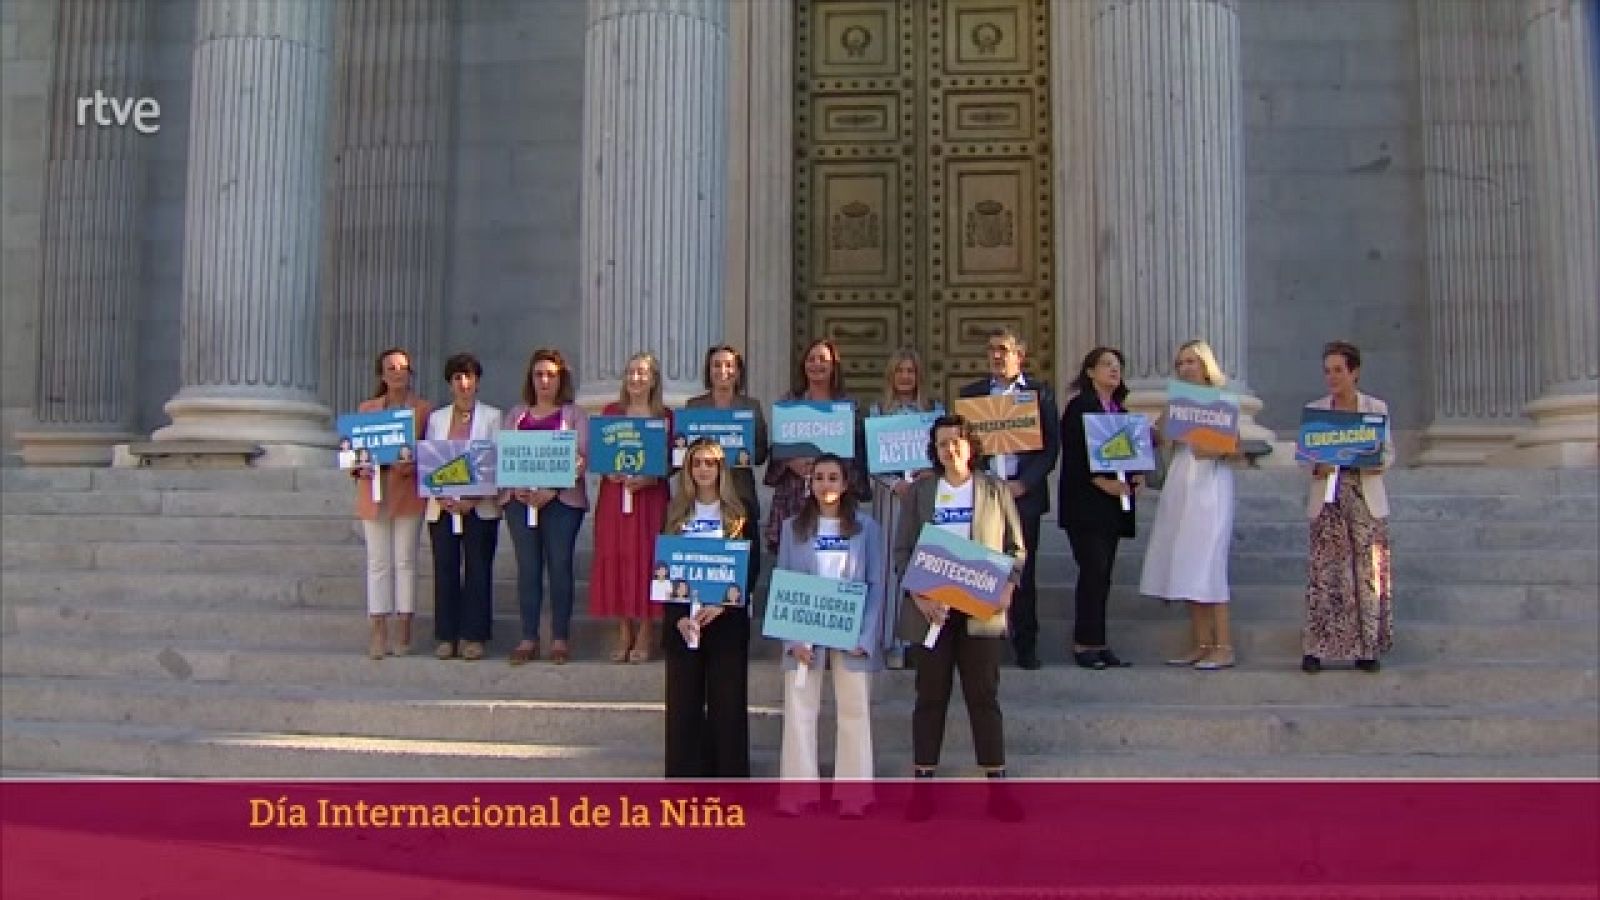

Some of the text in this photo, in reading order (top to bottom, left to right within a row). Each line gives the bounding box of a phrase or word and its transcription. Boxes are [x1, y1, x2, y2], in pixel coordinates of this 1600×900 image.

[1169, 404, 1232, 427] PROTECCIÓN
[781, 419, 845, 439] DERECHOS
[1304, 424, 1376, 448] EDUCACIÓN
[502, 445, 531, 458] HASTA
[534, 445, 570, 458] LOGRAR
[502, 459, 571, 473] LA IGUALDAD
[689, 567, 703, 581] LA
[707, 565, 736, 583] NIÑA
[914, 551, 999, 594] PROTECCIÓN
[776, 589, 857, 615] HASTA LOGRAR
[772, 604, 854, 633] LA IGUALDAD
